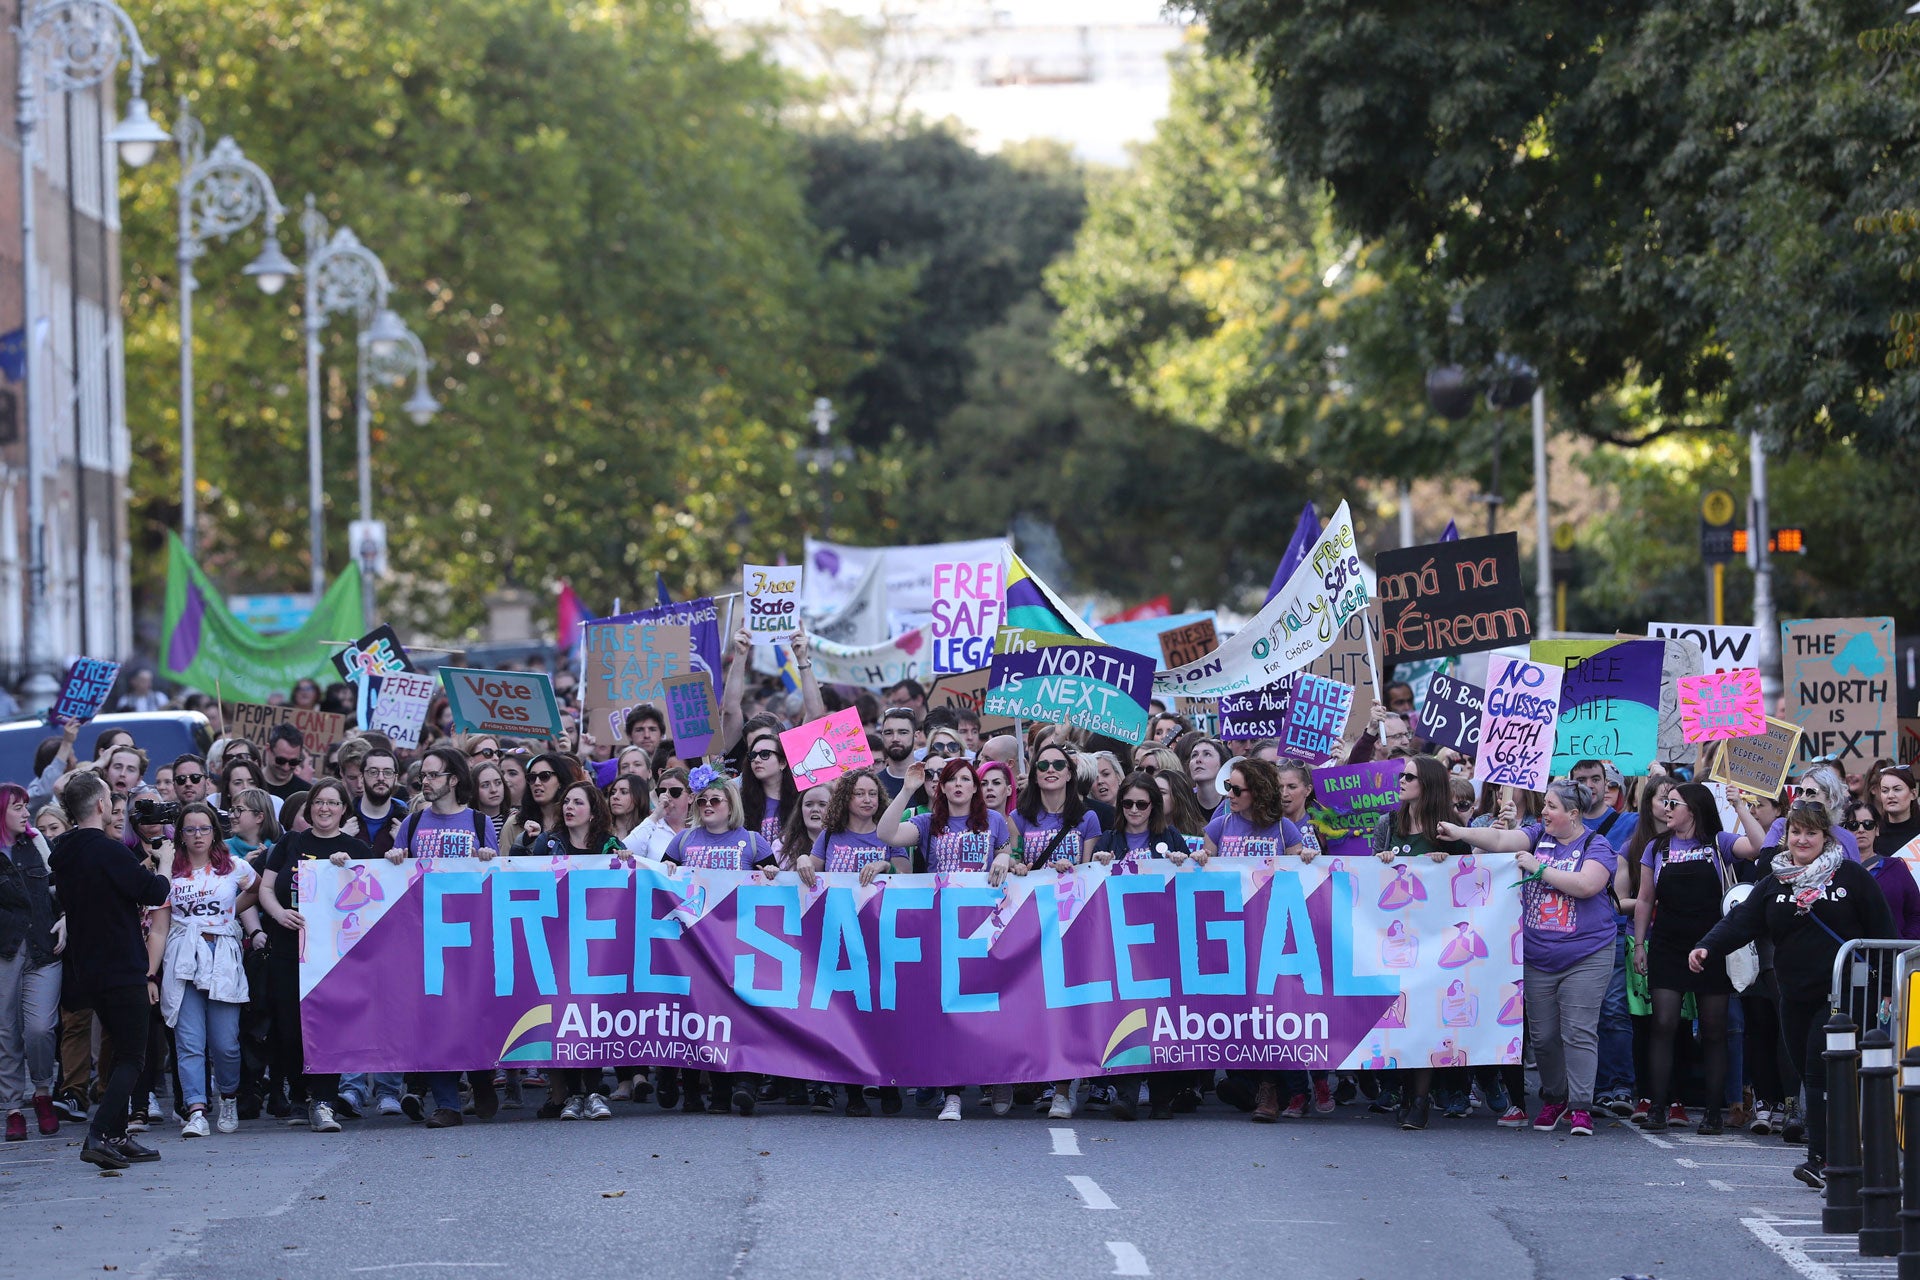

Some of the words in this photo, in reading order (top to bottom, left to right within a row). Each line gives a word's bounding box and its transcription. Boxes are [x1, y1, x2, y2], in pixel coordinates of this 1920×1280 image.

[747, 571, 797, 597] Free
[1324, 555, 1360, 604] Safe
[1456, 557, 1499, 591] na
[750, 598, 795, 616] Safe
[751, 615, 796, 632] LEGAL
[590, 625, 658, 652] FREE
[1792, 634, 1836, 656] THE
[602, 651, 679, 680] SAFE
[933, 636, 995, 673] LEGA
[999, 628, 1038, 655] The
[1037, 647, 1135, 694] NORTH
[1170, 638, 1213, 667] OUT
[73, 658, 120, 684] FREE
[1497, 660, 1546, 688] NO
[1564, 656, 1625, 683] FREE
[65, 679, 110, 704] SAFE
[384, 677, 433, 699] FREE
[463, 675, 532, 700] Vote
[607, 680, 666, 701] LEGA
[670, 682, 708, 701] FREE
[1000, 667, 1024, 692] is
[1036, 677, 1119, 717] NEXT.
[1297, 675, 1352, 710] FREE
[1433, 676, 1451, 700] Oh
[1799, 680, 1888, 706] NORTH
[235, 702, 292, 727] PEOPLE
[376, 698, 427, 723] SAFE
[479, 698, 530, 722] Yes
[1221, 696, 1254, 713] Safe
[1259, 691, 1291, 710] Abort
[1487, 687, 1557, 726] GUESSES
[1561, 686, 1619, 724] SAFE
[1706, 698, 1737, 714] LEFT
[1222, 716, 1277, 737] Access
[1291, 700, 1345, 737] SAFE
[1422, 701, 1448, 738] Up
[1455, 711, 1481, 748] Yo
[1829, 709, 1845, 723] IS
[1485, 718, 1543, 746] WITH
[1797, 730, 1887, 762] NEXT
[1323, 774, 1361, 793] IRISH
[1485, 756, 1539, 789] YESES
[175, 889, 213, 903] Together
[175, 900, 225, 918] Yes.
[1776, 890, 1839, 903] REAL
[422, 868, 692, 997] FREE
[734, 884, 1006, 1014] SAFE
[1034, 871, 1401, 1009] LEGAL
[556, 1003, 732, 1043] Abortion
[1152, 1005, 1329, 1042] Abortion
[556, 1042, 625, 1061] RIGHTS
[628, 1040, 729, 1065] CAMPAIGN
[1154, 1043, 1221, 1064] RIGHTS
[1225, 1044, 1329, 1063] CAMPAIGN
